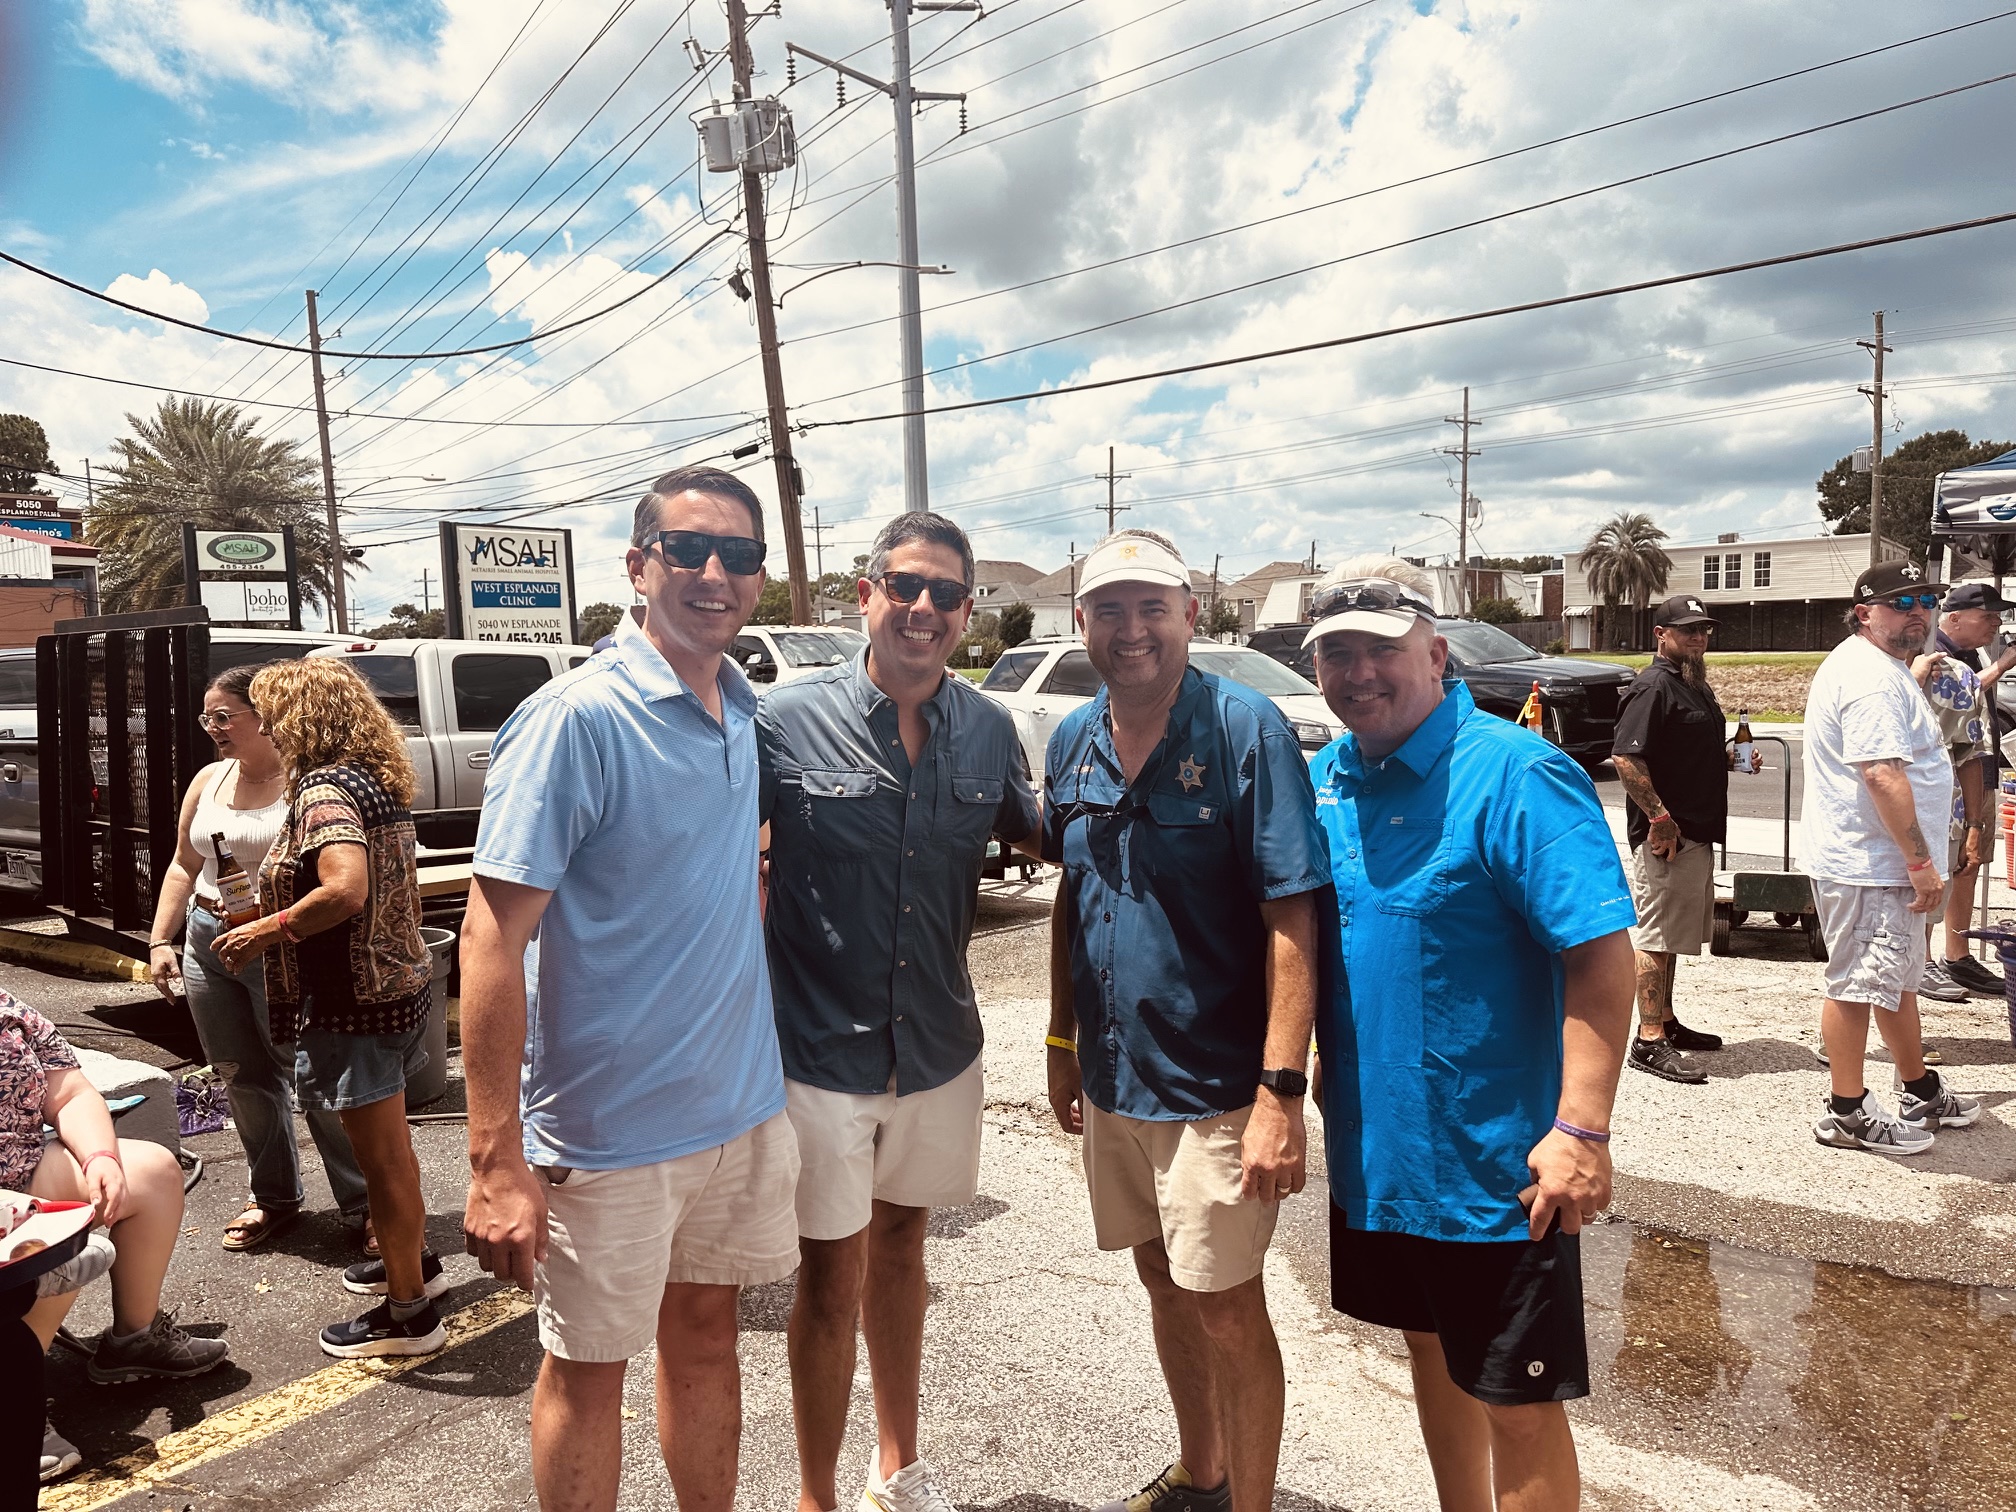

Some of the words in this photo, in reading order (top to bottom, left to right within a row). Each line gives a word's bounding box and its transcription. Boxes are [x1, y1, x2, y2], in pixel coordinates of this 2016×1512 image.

[16, 500, 41, 509] 5050
[223, 543, 259, 553] MSAH
[471, 536, 558, 568] MSAH
[474, 583, 501, 593] WEST
[504, 584, 559, 594] ESPLANADE
[247, 588, 287, 606] boho
[500, 596, 536, 606] CLINIC
[477, 619, 498, 629] 5040
[500, 620, 509, 628] W
[511, 619, 561, 629] ESPLANADE
